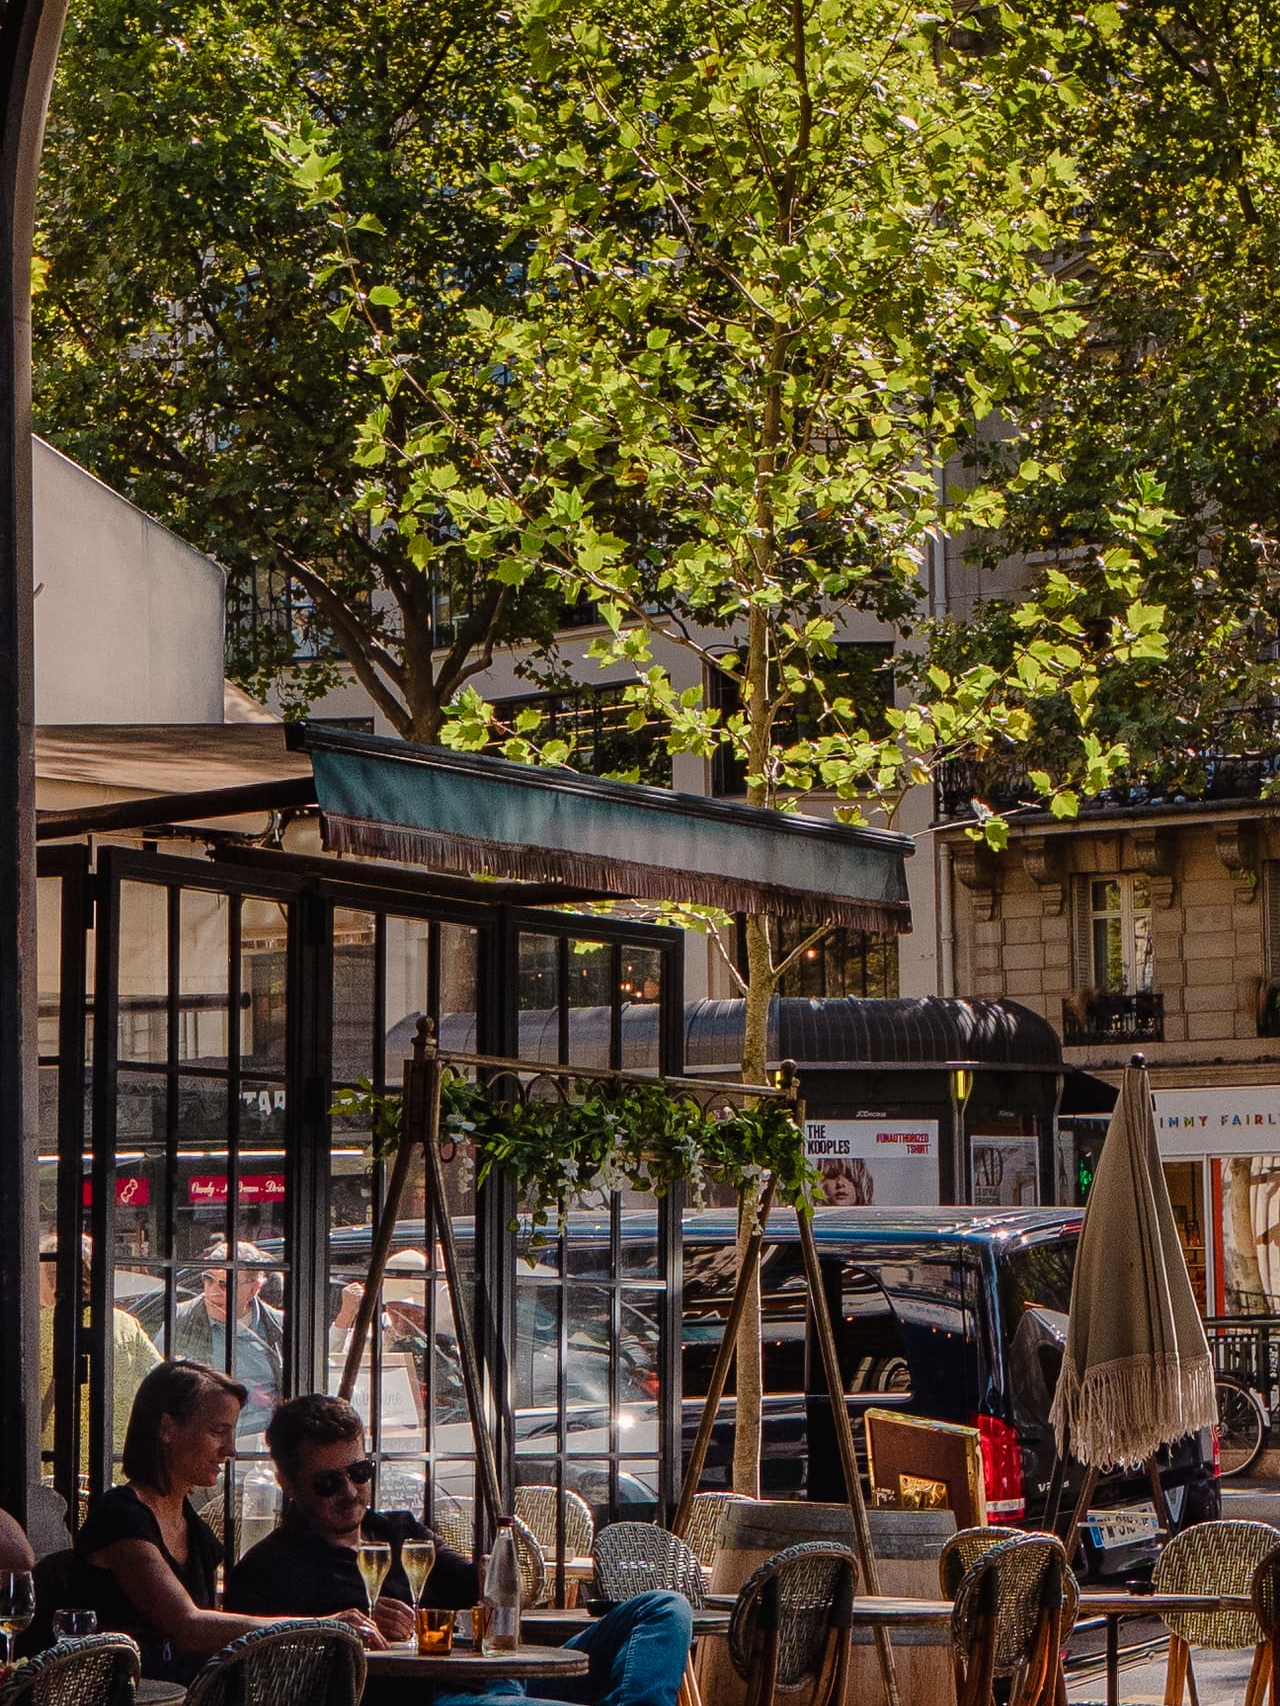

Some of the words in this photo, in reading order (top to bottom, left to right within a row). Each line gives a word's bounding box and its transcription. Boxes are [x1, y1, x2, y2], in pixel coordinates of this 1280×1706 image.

[1160, 1116, 1208, 1129] IMMY
[807, 1124, 827, 1139] THE
[807, 1140, 850, 1155] KOOPLES
